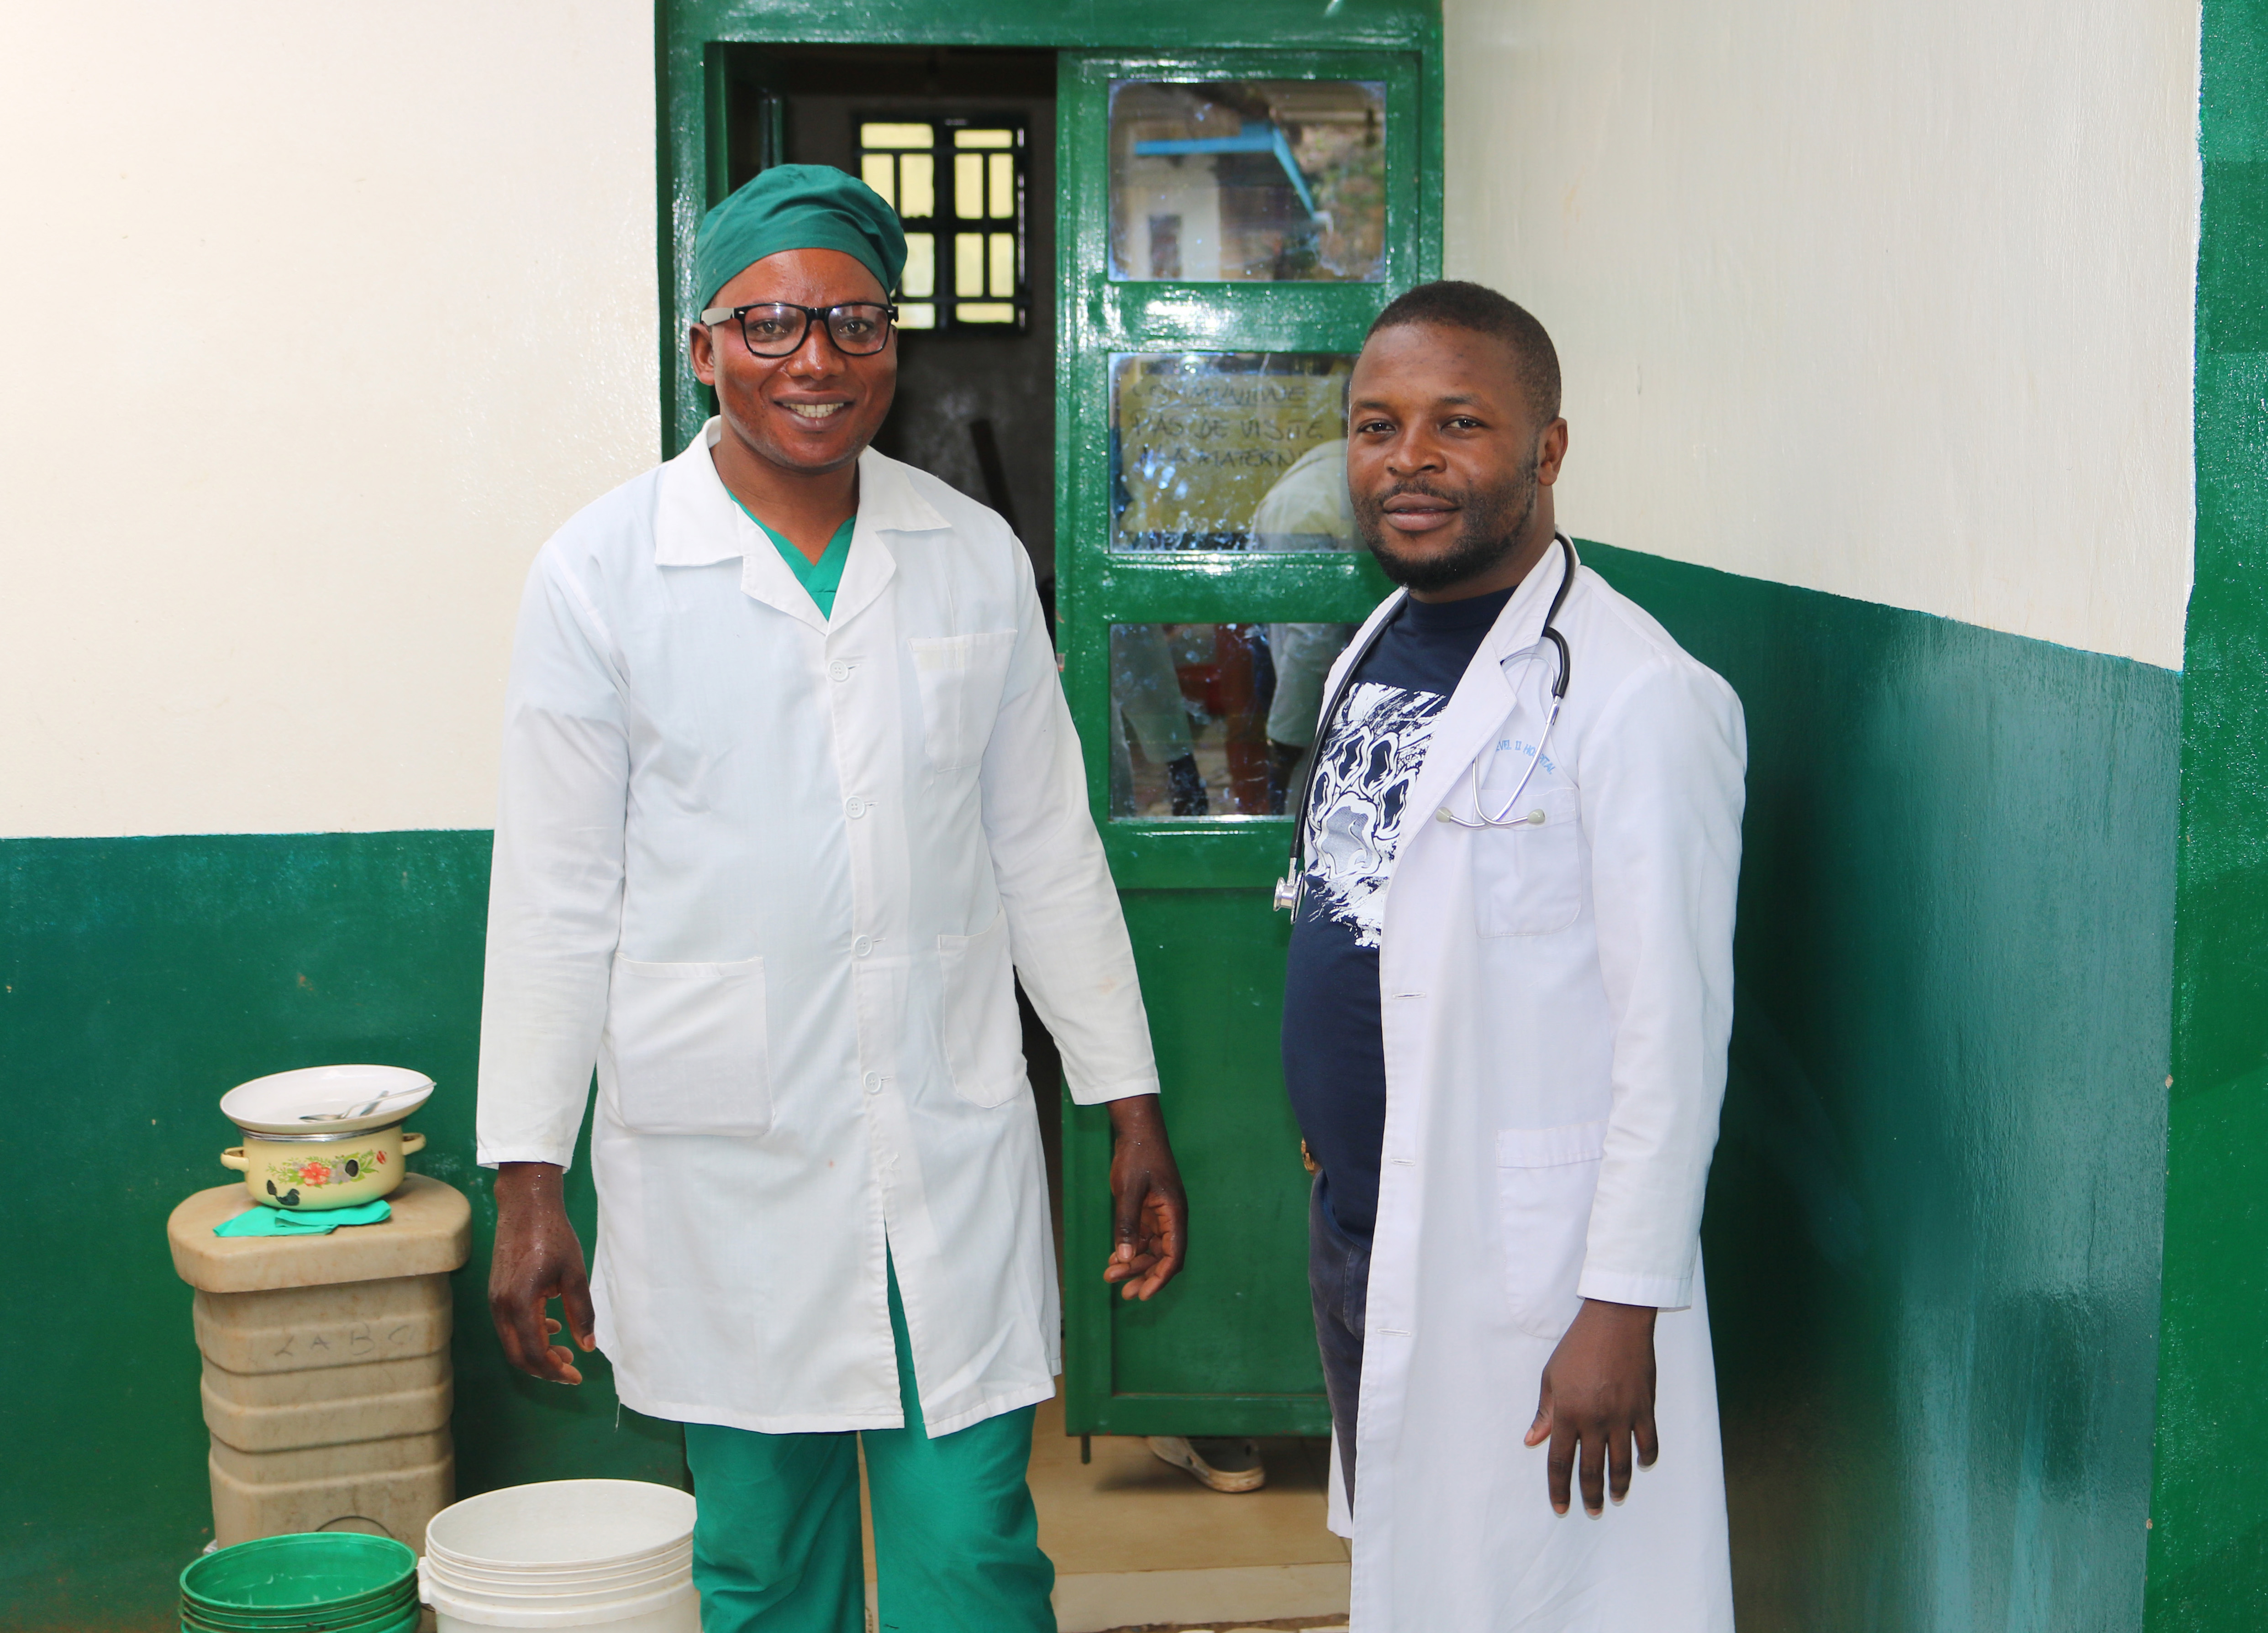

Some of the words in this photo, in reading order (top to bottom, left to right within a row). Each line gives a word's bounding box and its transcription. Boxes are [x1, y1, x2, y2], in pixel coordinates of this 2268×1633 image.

[1131, 409, 1184, 437] PAS
[1194, 416, 1229, 439] DE
[1240, 417, 1323, 441] VISITE
[1522, 743, 1556, 775] HOPITAL
